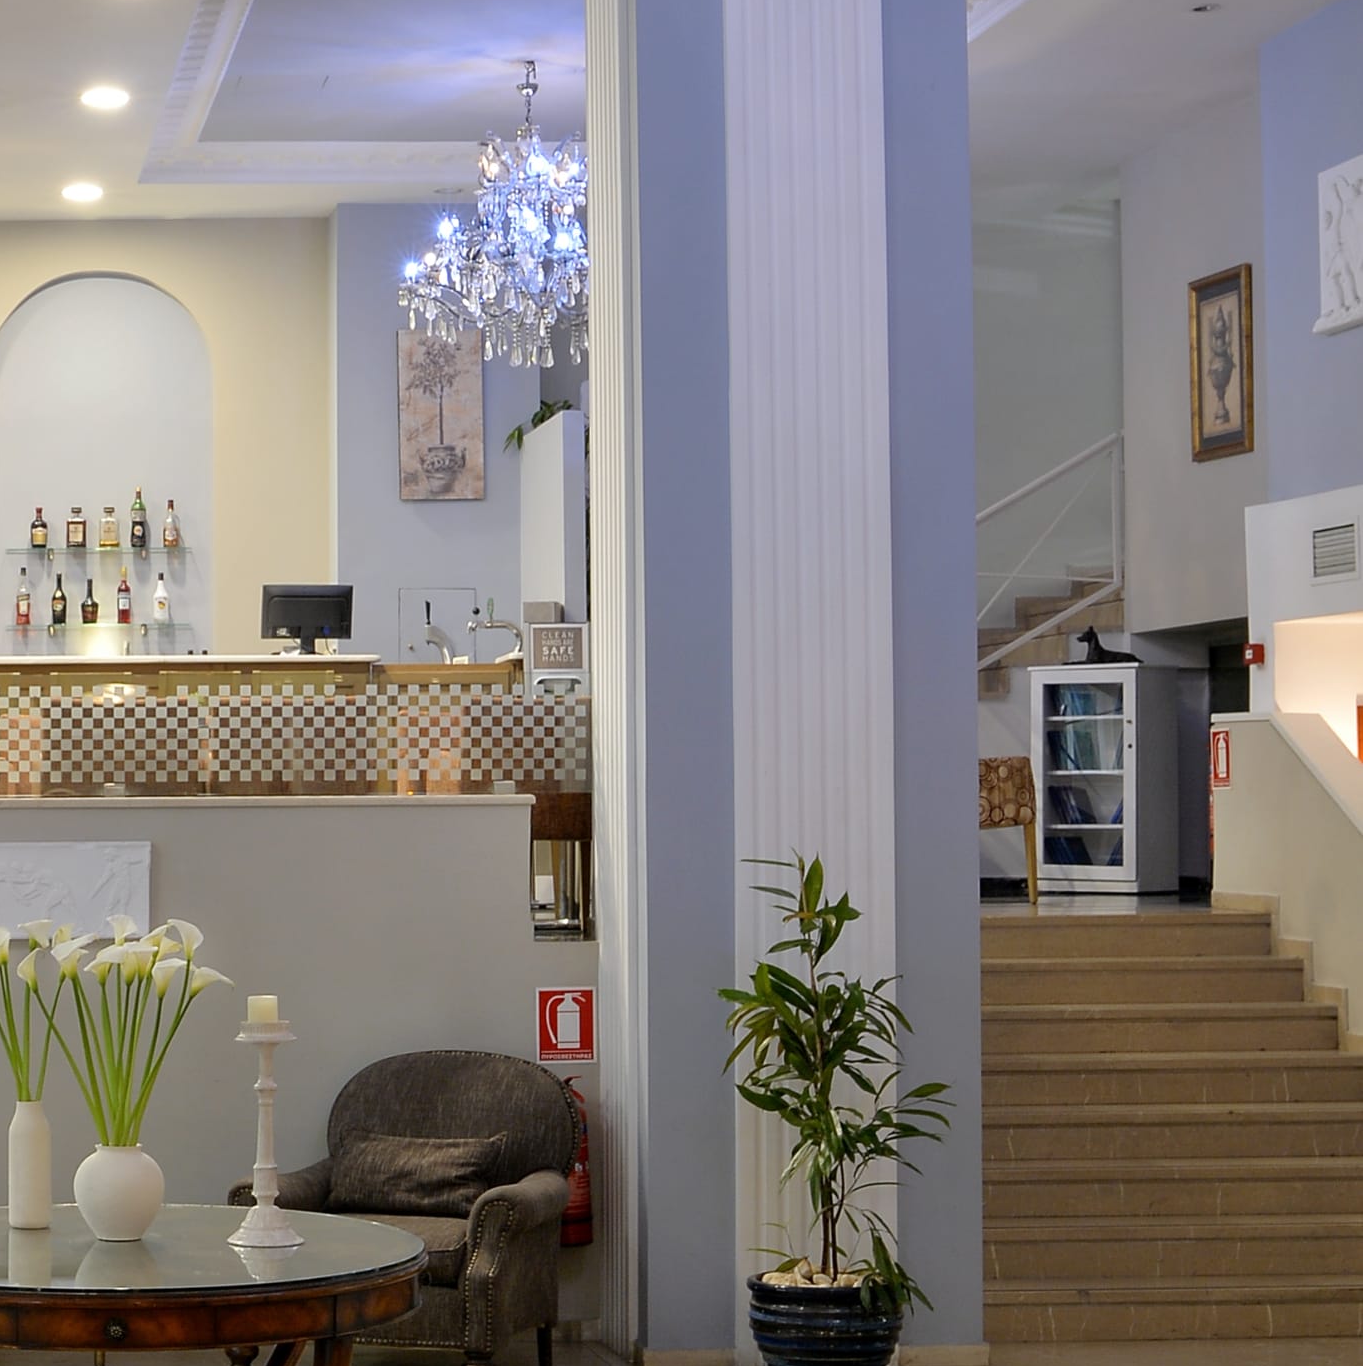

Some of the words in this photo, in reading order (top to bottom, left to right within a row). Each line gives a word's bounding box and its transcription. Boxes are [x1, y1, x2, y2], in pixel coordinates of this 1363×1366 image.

[541, 631, 574, 639] CLEAN
[542, 646, 574, 655] SAFE
[541, 655, 574, 663] HANDS
